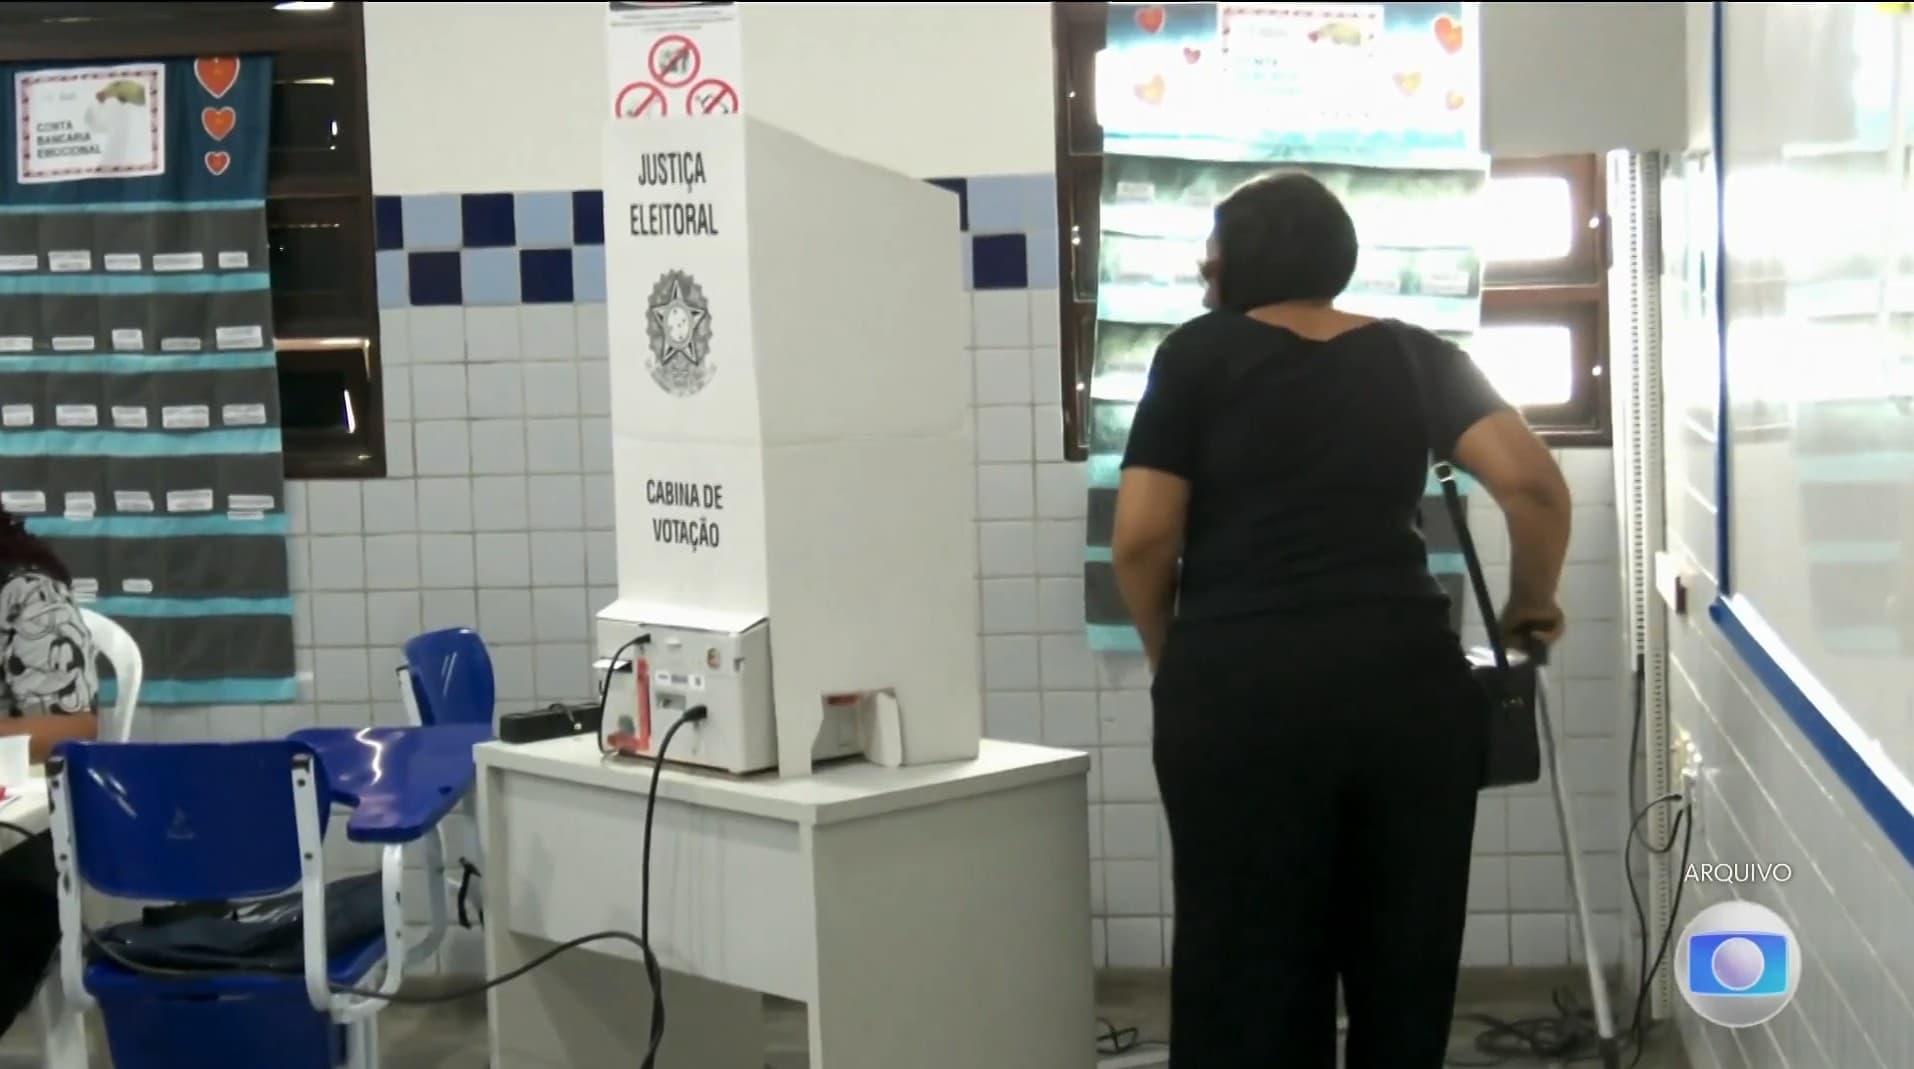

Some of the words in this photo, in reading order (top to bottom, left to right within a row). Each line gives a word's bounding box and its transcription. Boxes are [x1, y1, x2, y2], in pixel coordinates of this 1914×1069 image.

[638, 151, 706, 193] JUSTIÇA
[630, 202, 719, 236] ELEITORAL
[646, 478, 700, 508] CABINA
[703, 483, 724, 510] DE
[652, 515, 720, 553] VOTAÇÃO
